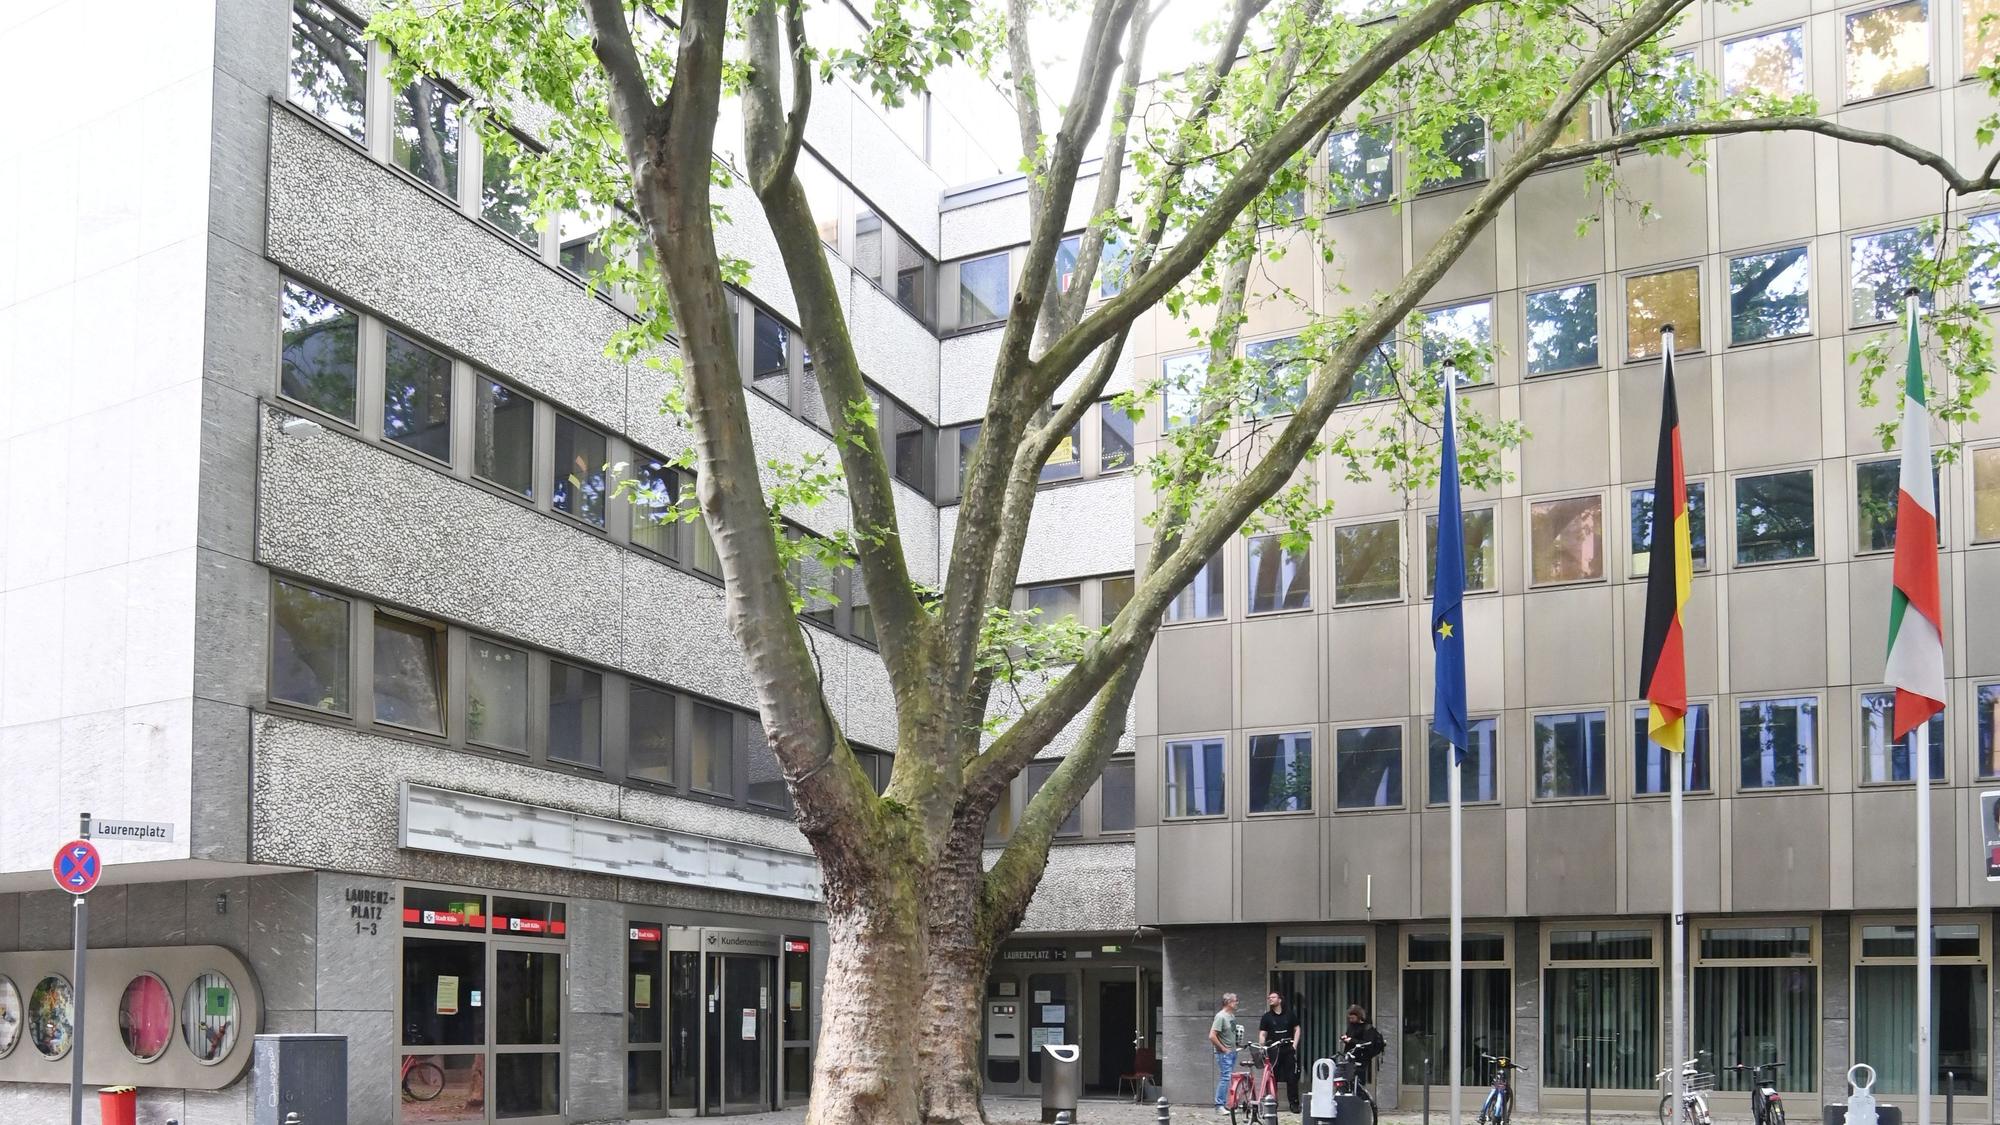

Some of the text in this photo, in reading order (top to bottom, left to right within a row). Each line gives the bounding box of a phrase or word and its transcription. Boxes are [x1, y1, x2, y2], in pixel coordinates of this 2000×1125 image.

[98, 821, 166, 839] Laurenzplatz
[351, 905, 382, 920] PLATZ
[355, 921, 377, 936] 1-3
